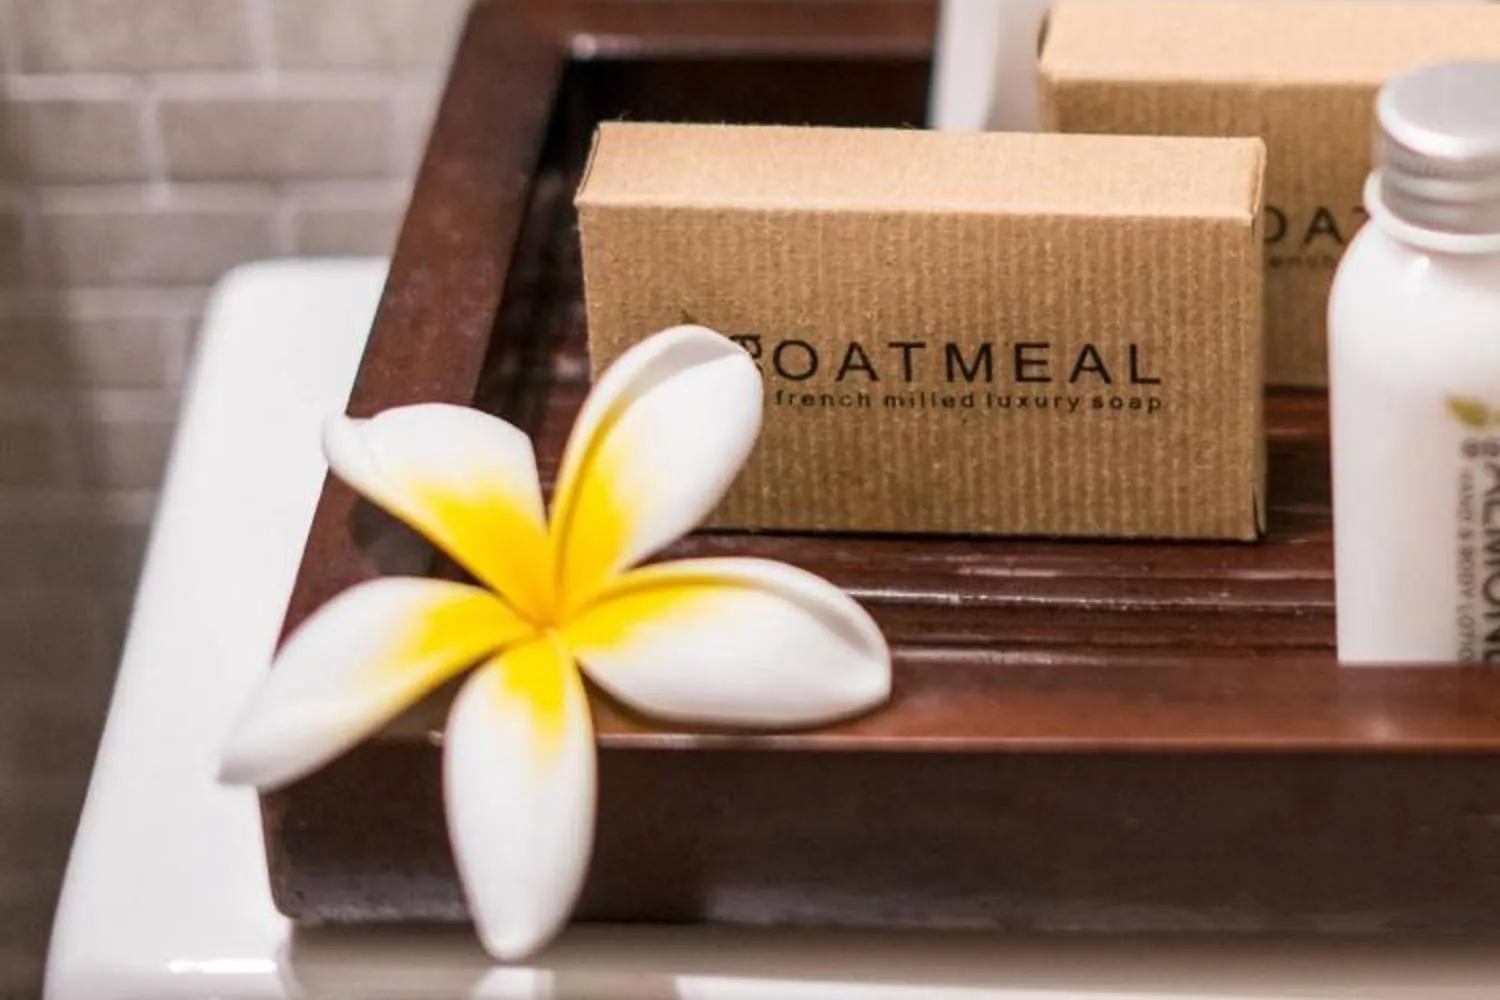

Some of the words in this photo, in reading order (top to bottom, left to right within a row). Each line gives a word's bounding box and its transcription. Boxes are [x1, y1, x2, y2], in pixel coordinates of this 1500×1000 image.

[772, 339, 1162, 385] OATMEAL
[776, 389, 871, 408] french
[883, 389, 975, 409] milled
[987, 390, 1081, 411] luxury
[1092, 393, 1162, 413] soap
[1457, 604, 1477, 663] LOTIO
